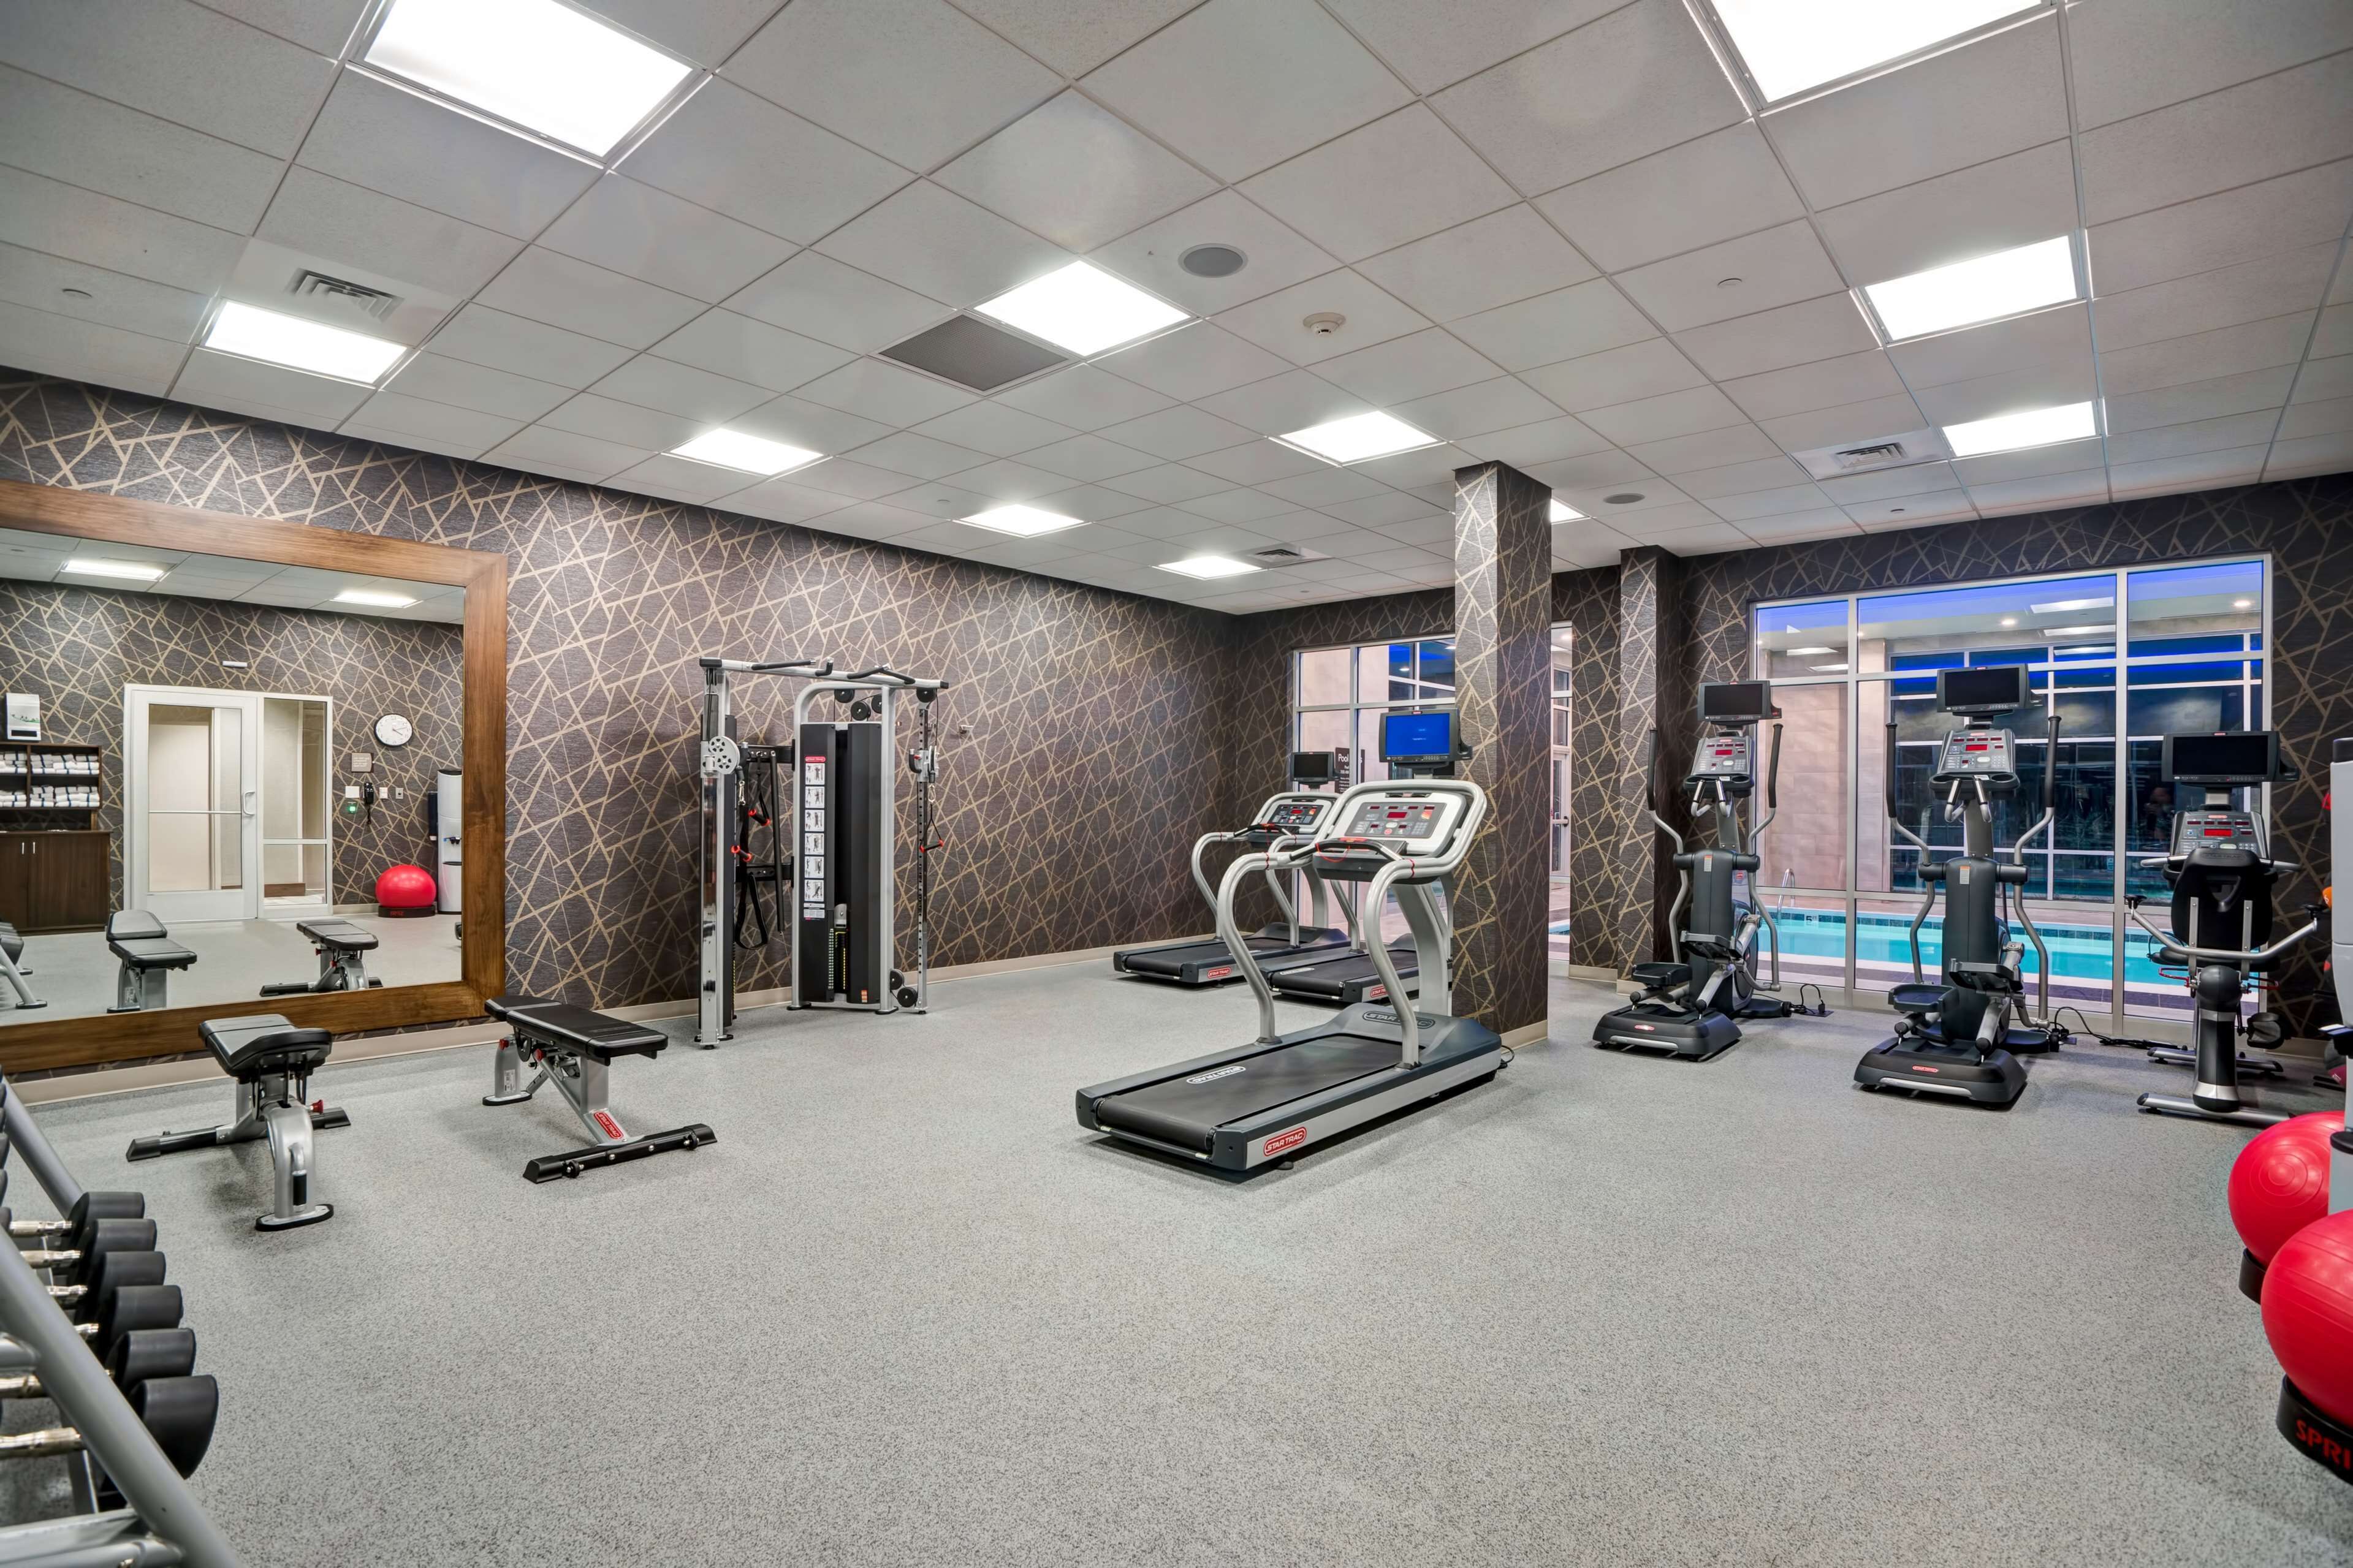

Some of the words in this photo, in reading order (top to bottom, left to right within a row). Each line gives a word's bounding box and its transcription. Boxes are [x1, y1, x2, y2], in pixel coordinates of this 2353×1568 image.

[1338, 754, 1348, 762] Pool
[1192, 1074, 1220, 1083] TRAC
[598, 1113, 610, 1126] STAR
[607, 1124, 620, 1137] TRAC
[1266, 1139, 1285, 1151] STAR
[1285, 1132, 1303, 1145] TRAC
[2295, 1419, 2351, 1471] SPRI
